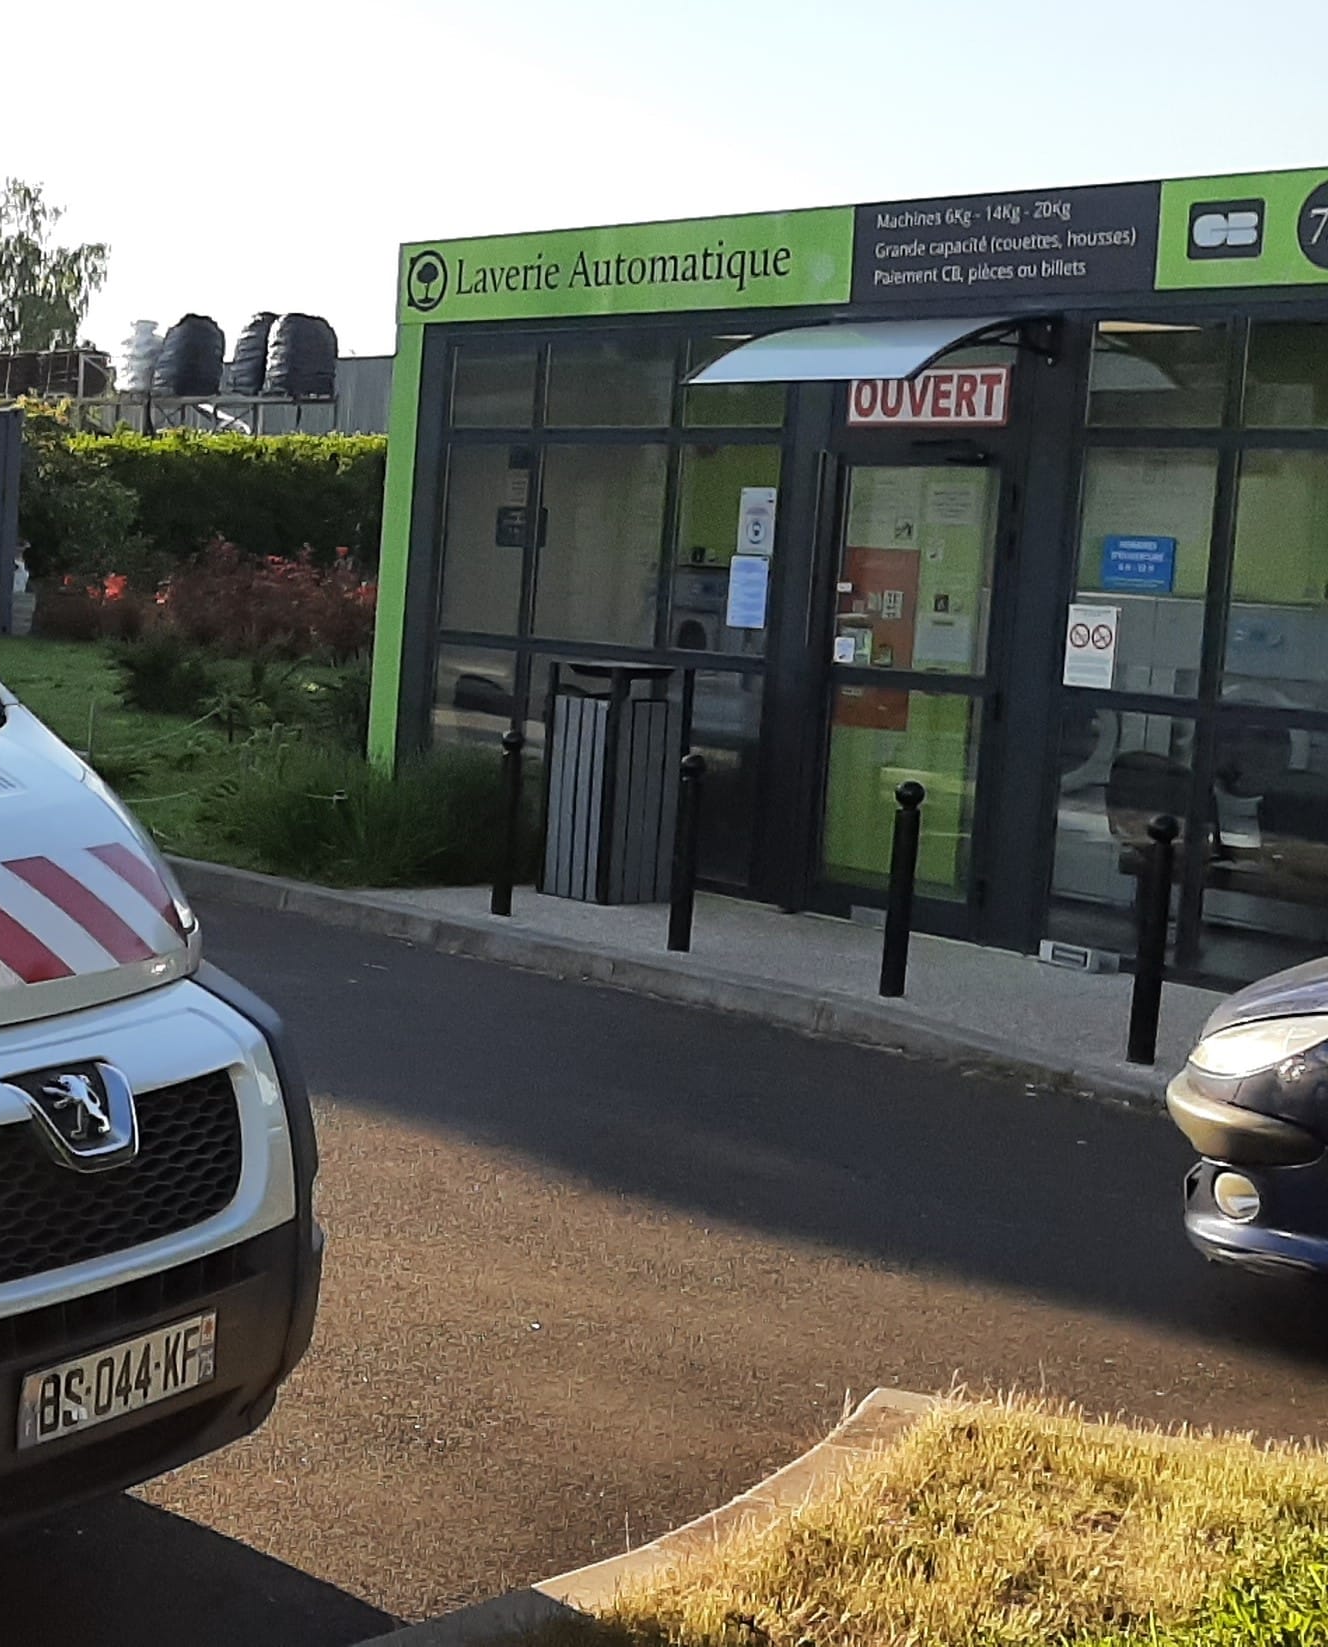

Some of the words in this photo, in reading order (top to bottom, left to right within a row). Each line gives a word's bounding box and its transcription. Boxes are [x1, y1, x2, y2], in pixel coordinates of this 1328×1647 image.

[876, 210, 942, 229] Machines
[945, 207, 972, 228] 6Kg
[986, 203, 1020, 224] 14Kg
[1033, 200, 1071, 221] 20Kg
[875, 238, 926, 259] Grande
[929, 235, 987, 259] capacité
[991, 233, 1062, 254] (couettes,
[1067, 226, 1136, 249] housses)
[455, 252, 560, 296] Laverie
[568, 240, 792, 292] Automatique
[874, 266, 938, 286] Paiement
[968, 262, 1014, 285] pièces
[1018, 265, 1037, 279] ou
[1042, 258, 1087, 280] billets
[854, 373, 1003, 418] OUVERT
